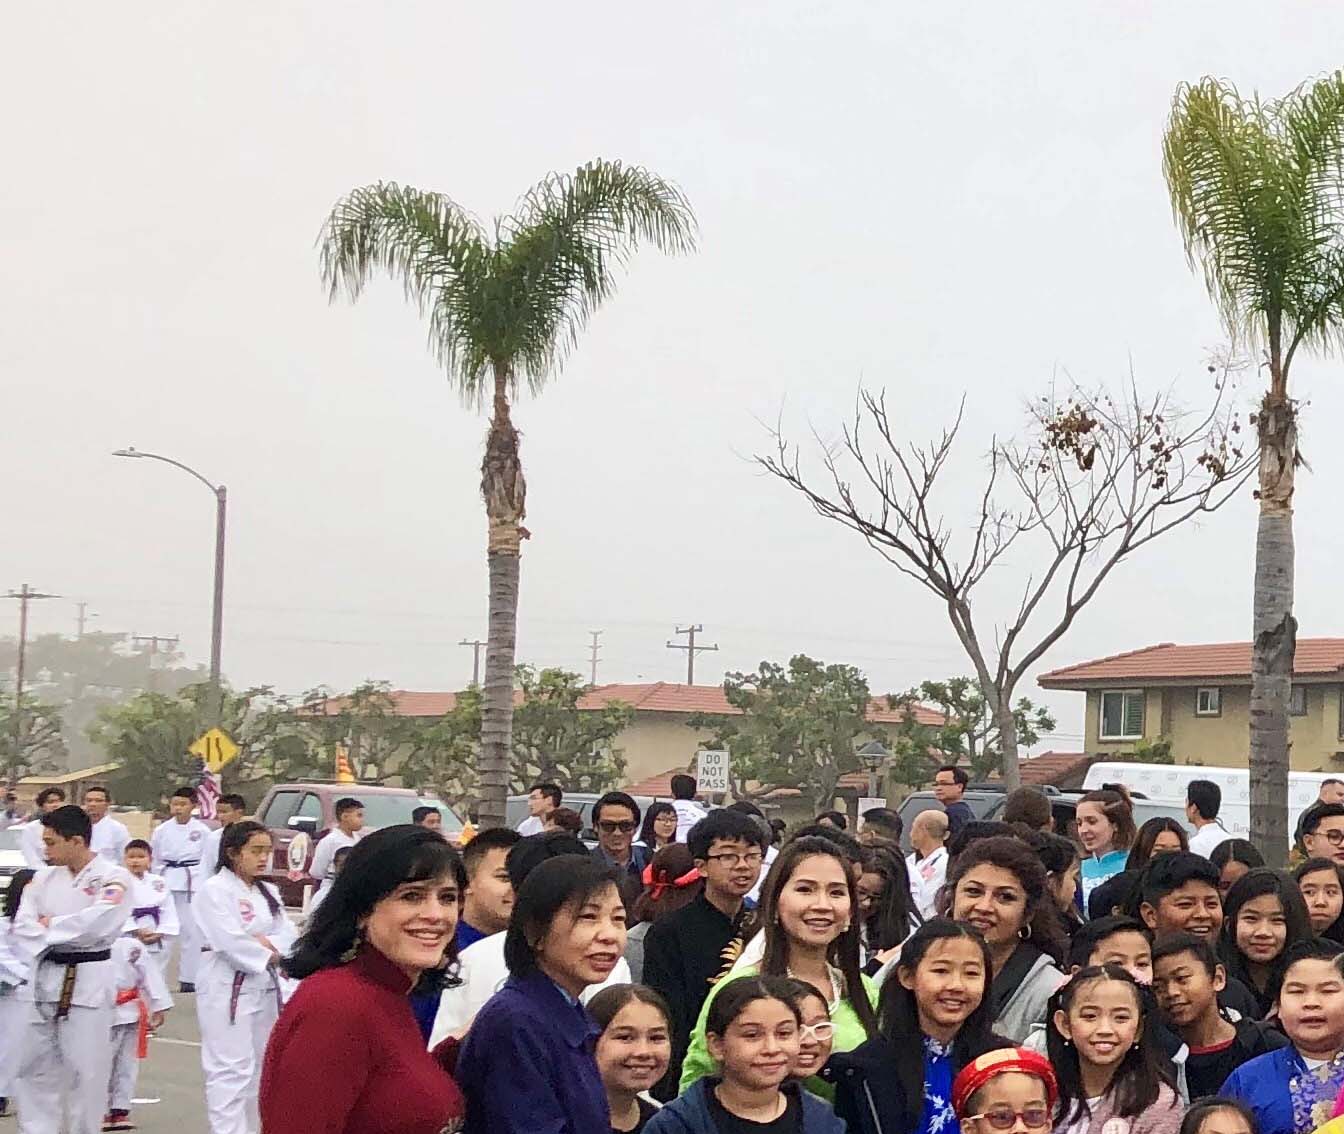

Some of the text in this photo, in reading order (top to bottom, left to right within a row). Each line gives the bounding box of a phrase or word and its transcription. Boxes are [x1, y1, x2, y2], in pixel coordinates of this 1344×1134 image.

[706, 754, 720, 764] DO
[702, 766, 723, 776] NOT
[700, 778, 726, 788] PASS
